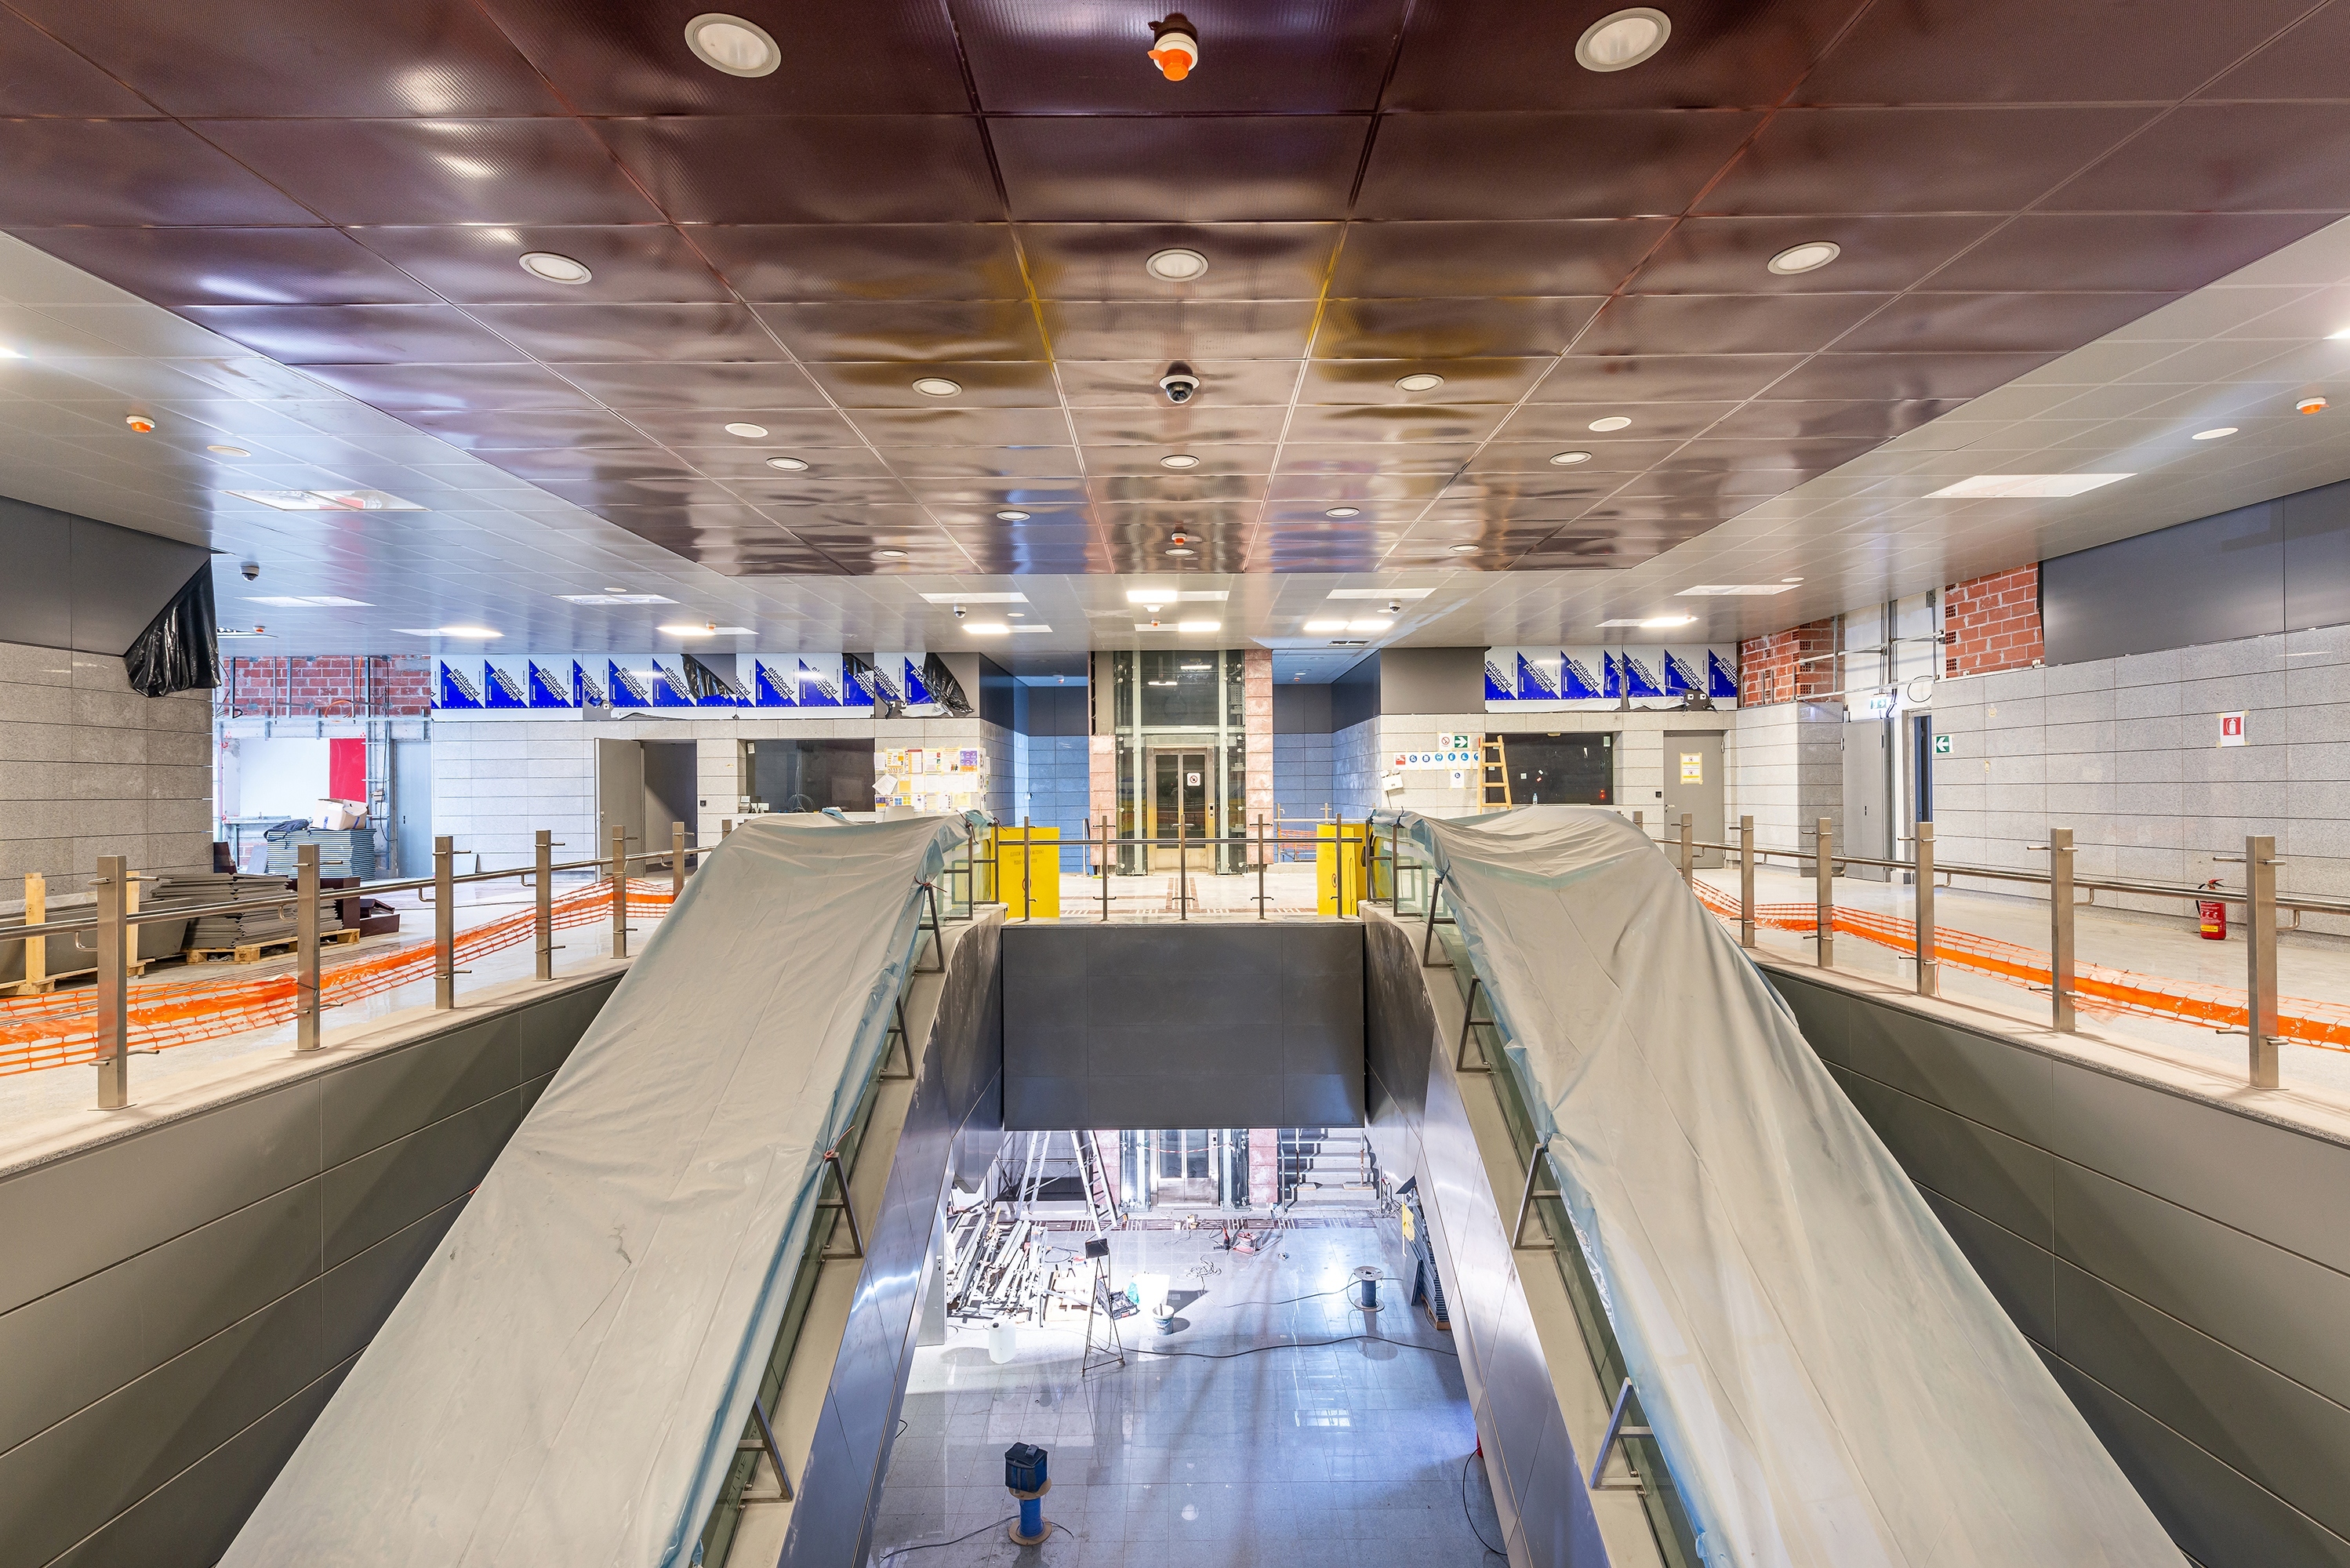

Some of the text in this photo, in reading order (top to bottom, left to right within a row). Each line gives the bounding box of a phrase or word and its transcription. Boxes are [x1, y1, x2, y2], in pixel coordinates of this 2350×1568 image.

[453, 668, 480, 697] etalbond
[498, 668, 525, 696] etalbond
[542, 668, 568, 696] etalbond
[583, 670, 605, 695] talbond
[621, 667, 648, 695] etalbond
[768, 667, 794, 695] etalbond
[1486, 660, 1513, 688] etalbond
[1573, 659, 1600, 687] etalbond
[1677, 658, 1704, 686] etalbond
